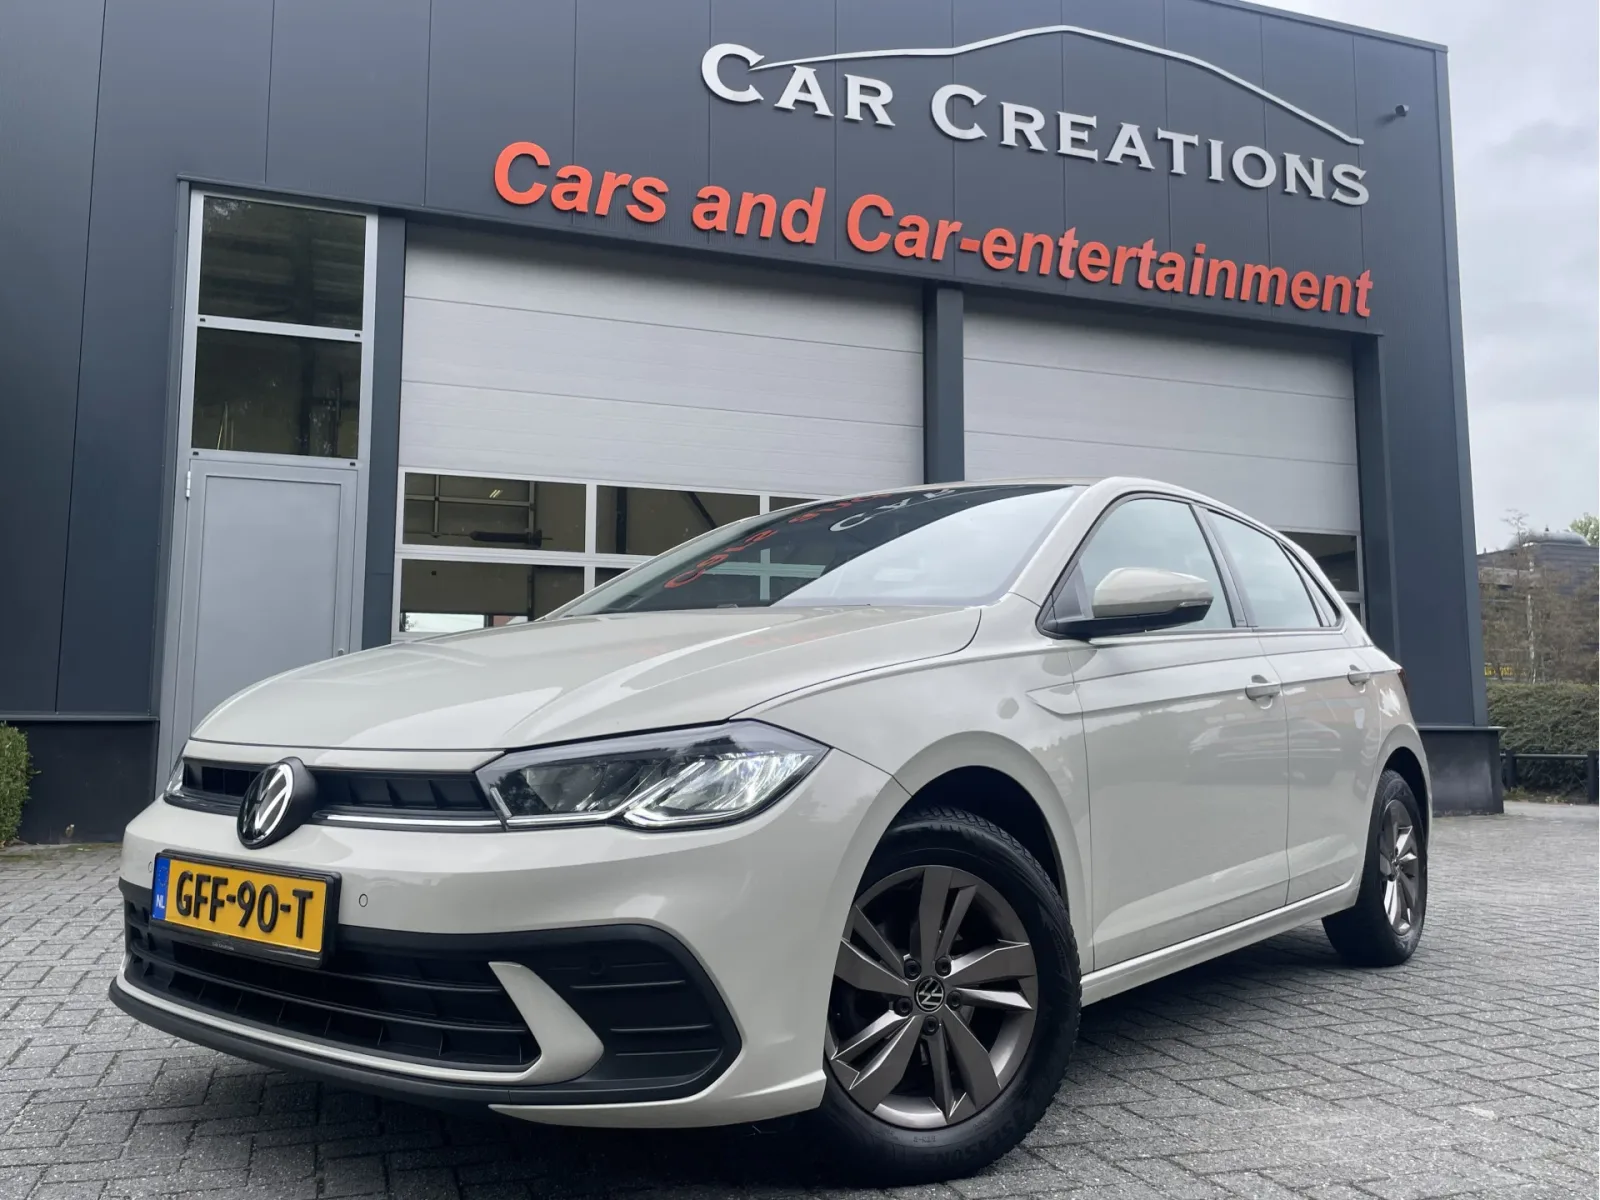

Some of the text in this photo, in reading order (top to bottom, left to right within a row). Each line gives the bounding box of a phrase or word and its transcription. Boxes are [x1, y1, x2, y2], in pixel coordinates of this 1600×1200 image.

[701, 43, 1370, 206] CAR CREATIONS
[493, 141, 1373, 318] Cars and Car-entertainment
[155, 894, 166, 910] NL
[176, 870, 314, 940] GFF-90-T
